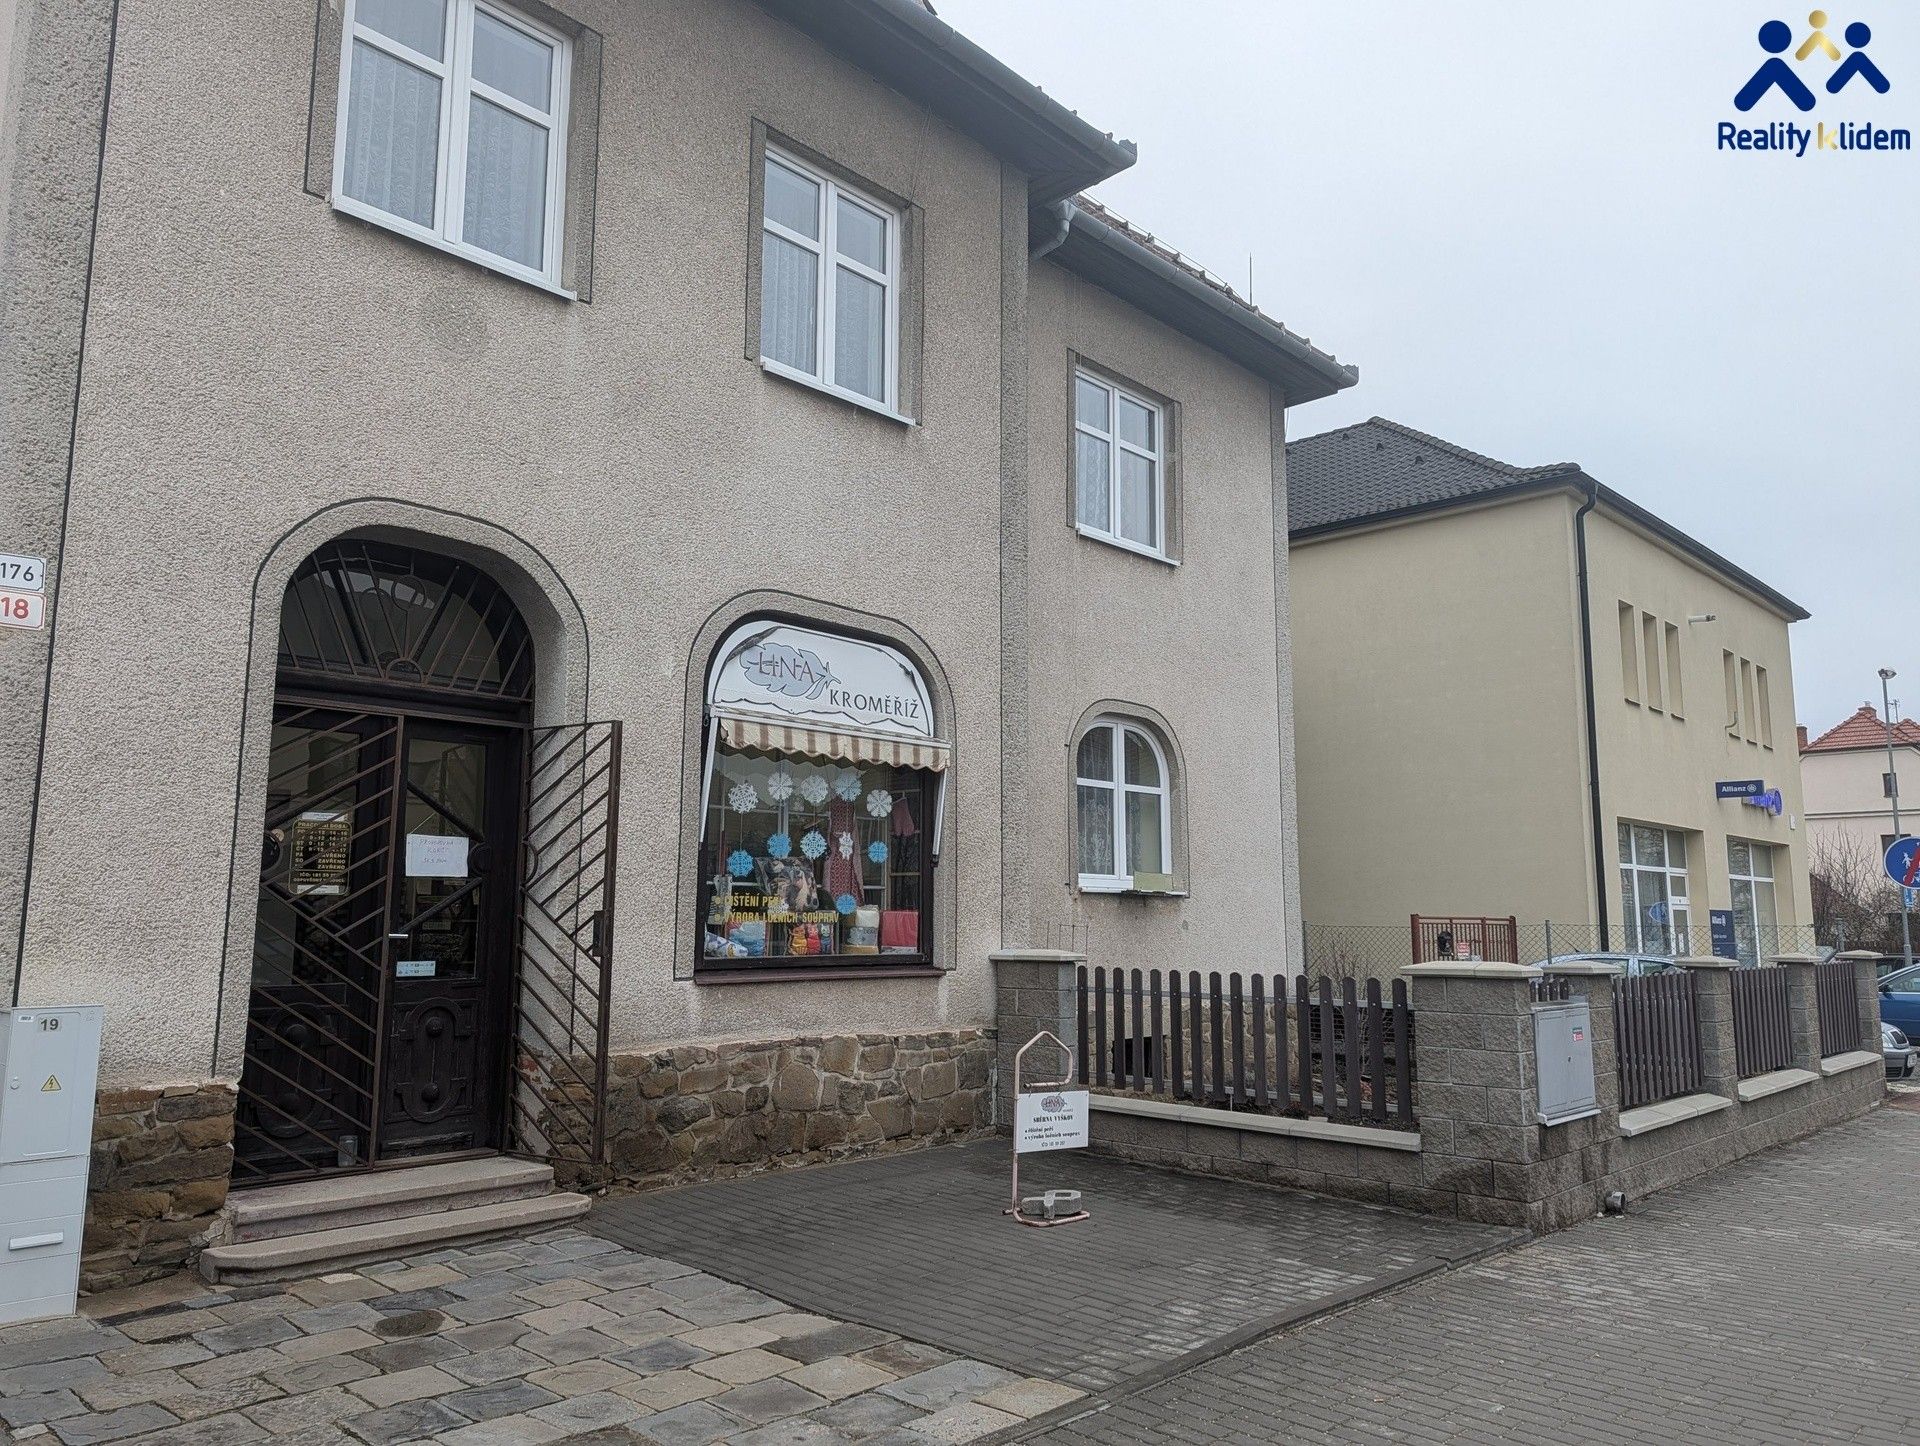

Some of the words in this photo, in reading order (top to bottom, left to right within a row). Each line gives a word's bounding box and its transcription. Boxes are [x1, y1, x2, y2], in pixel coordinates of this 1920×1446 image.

[0, 562, 35, 582] 176
[0, 596, 29, 620] 18
[829, 688, 920, 720] KROMĚŘÍŽ
[1721, 785, 1747, 793] Allianz
[723, 908, 761, 923] VÝROBA
[40, 1018, 59, 1031] 19
